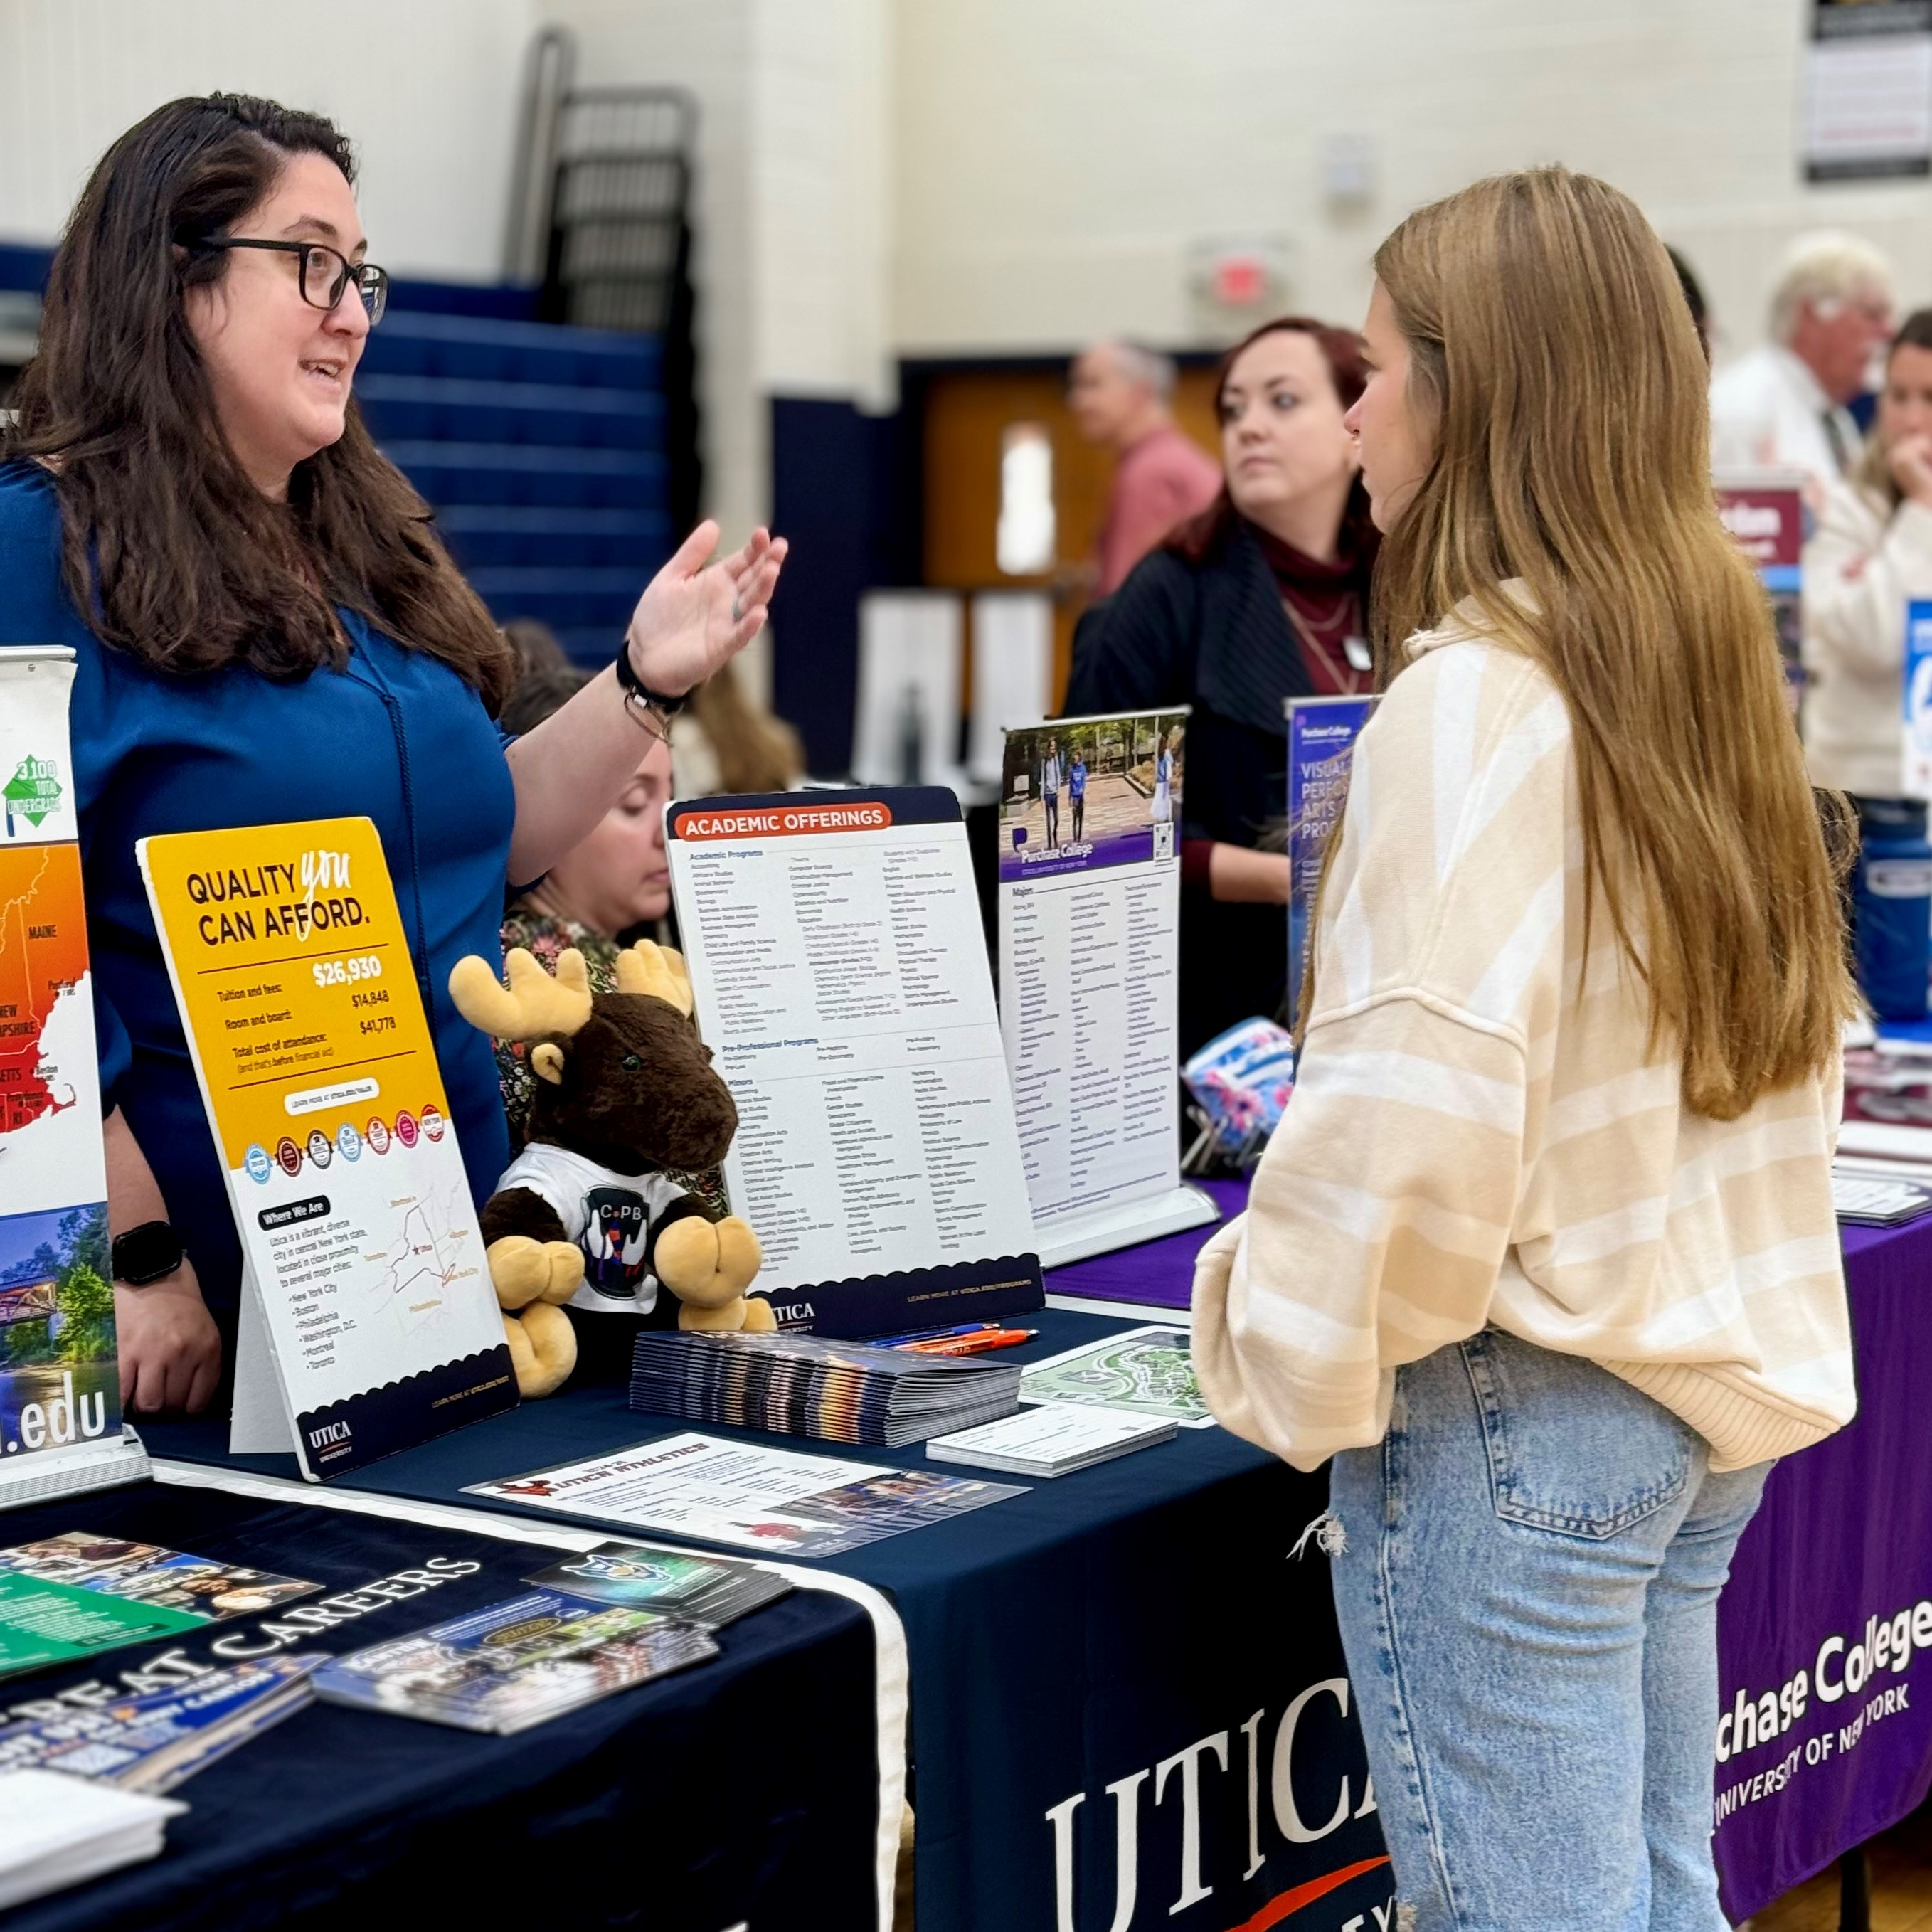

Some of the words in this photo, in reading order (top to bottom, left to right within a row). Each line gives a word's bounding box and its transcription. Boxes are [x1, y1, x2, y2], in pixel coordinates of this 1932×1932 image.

[685, 813, 780, 836] ACADEMIC
[783, 809, 883, 830] OFFERINGS
[1060, 844, 1093, 859] College
[186, 864, 297, 904] QUALITY
[297, 850, 352, 942] you
[28, 925, 58, 939] MAINE
[199, 911, 256, 945] CAN
[265, 896, 370, 935] AFFORD.
[313, 955, 382, 988] $26,930
[216, 986, 246, 1002] Tuition
[247, 984, 262, 997] and
[351, 989, 390, 1009] $14,848
[225, 1019, 249, 1031] Room
[250, 1014, 266, 1026] and
[360, 1016, 396, 1034] $41,778
[232, 1044, 253, 1058] Total
[254, 1040, 271, 1055] cost
[272, 1039, 282, 1051] of
[262, 1210, 293, 1225] Where
[292, 1206, 307, 1218] We
[308, 1202, 324, 1214] Are
[771, 1302, 816, 1322] TICA
[0, 1371, 105, 1455] .edu
[309, 1421, 353, 1448] UTICA
[613, 1443, 710, 1472] ATHLETICS
[211, 1557, 480, 1658] CAREERS
[1815, 1600, 1932, 1702] College
[1805, 1734, 1835, 1766] OF
[1865, 1683, 1910, 1726] YORK
[1045, 1677, 1378, 1932] UTIC
